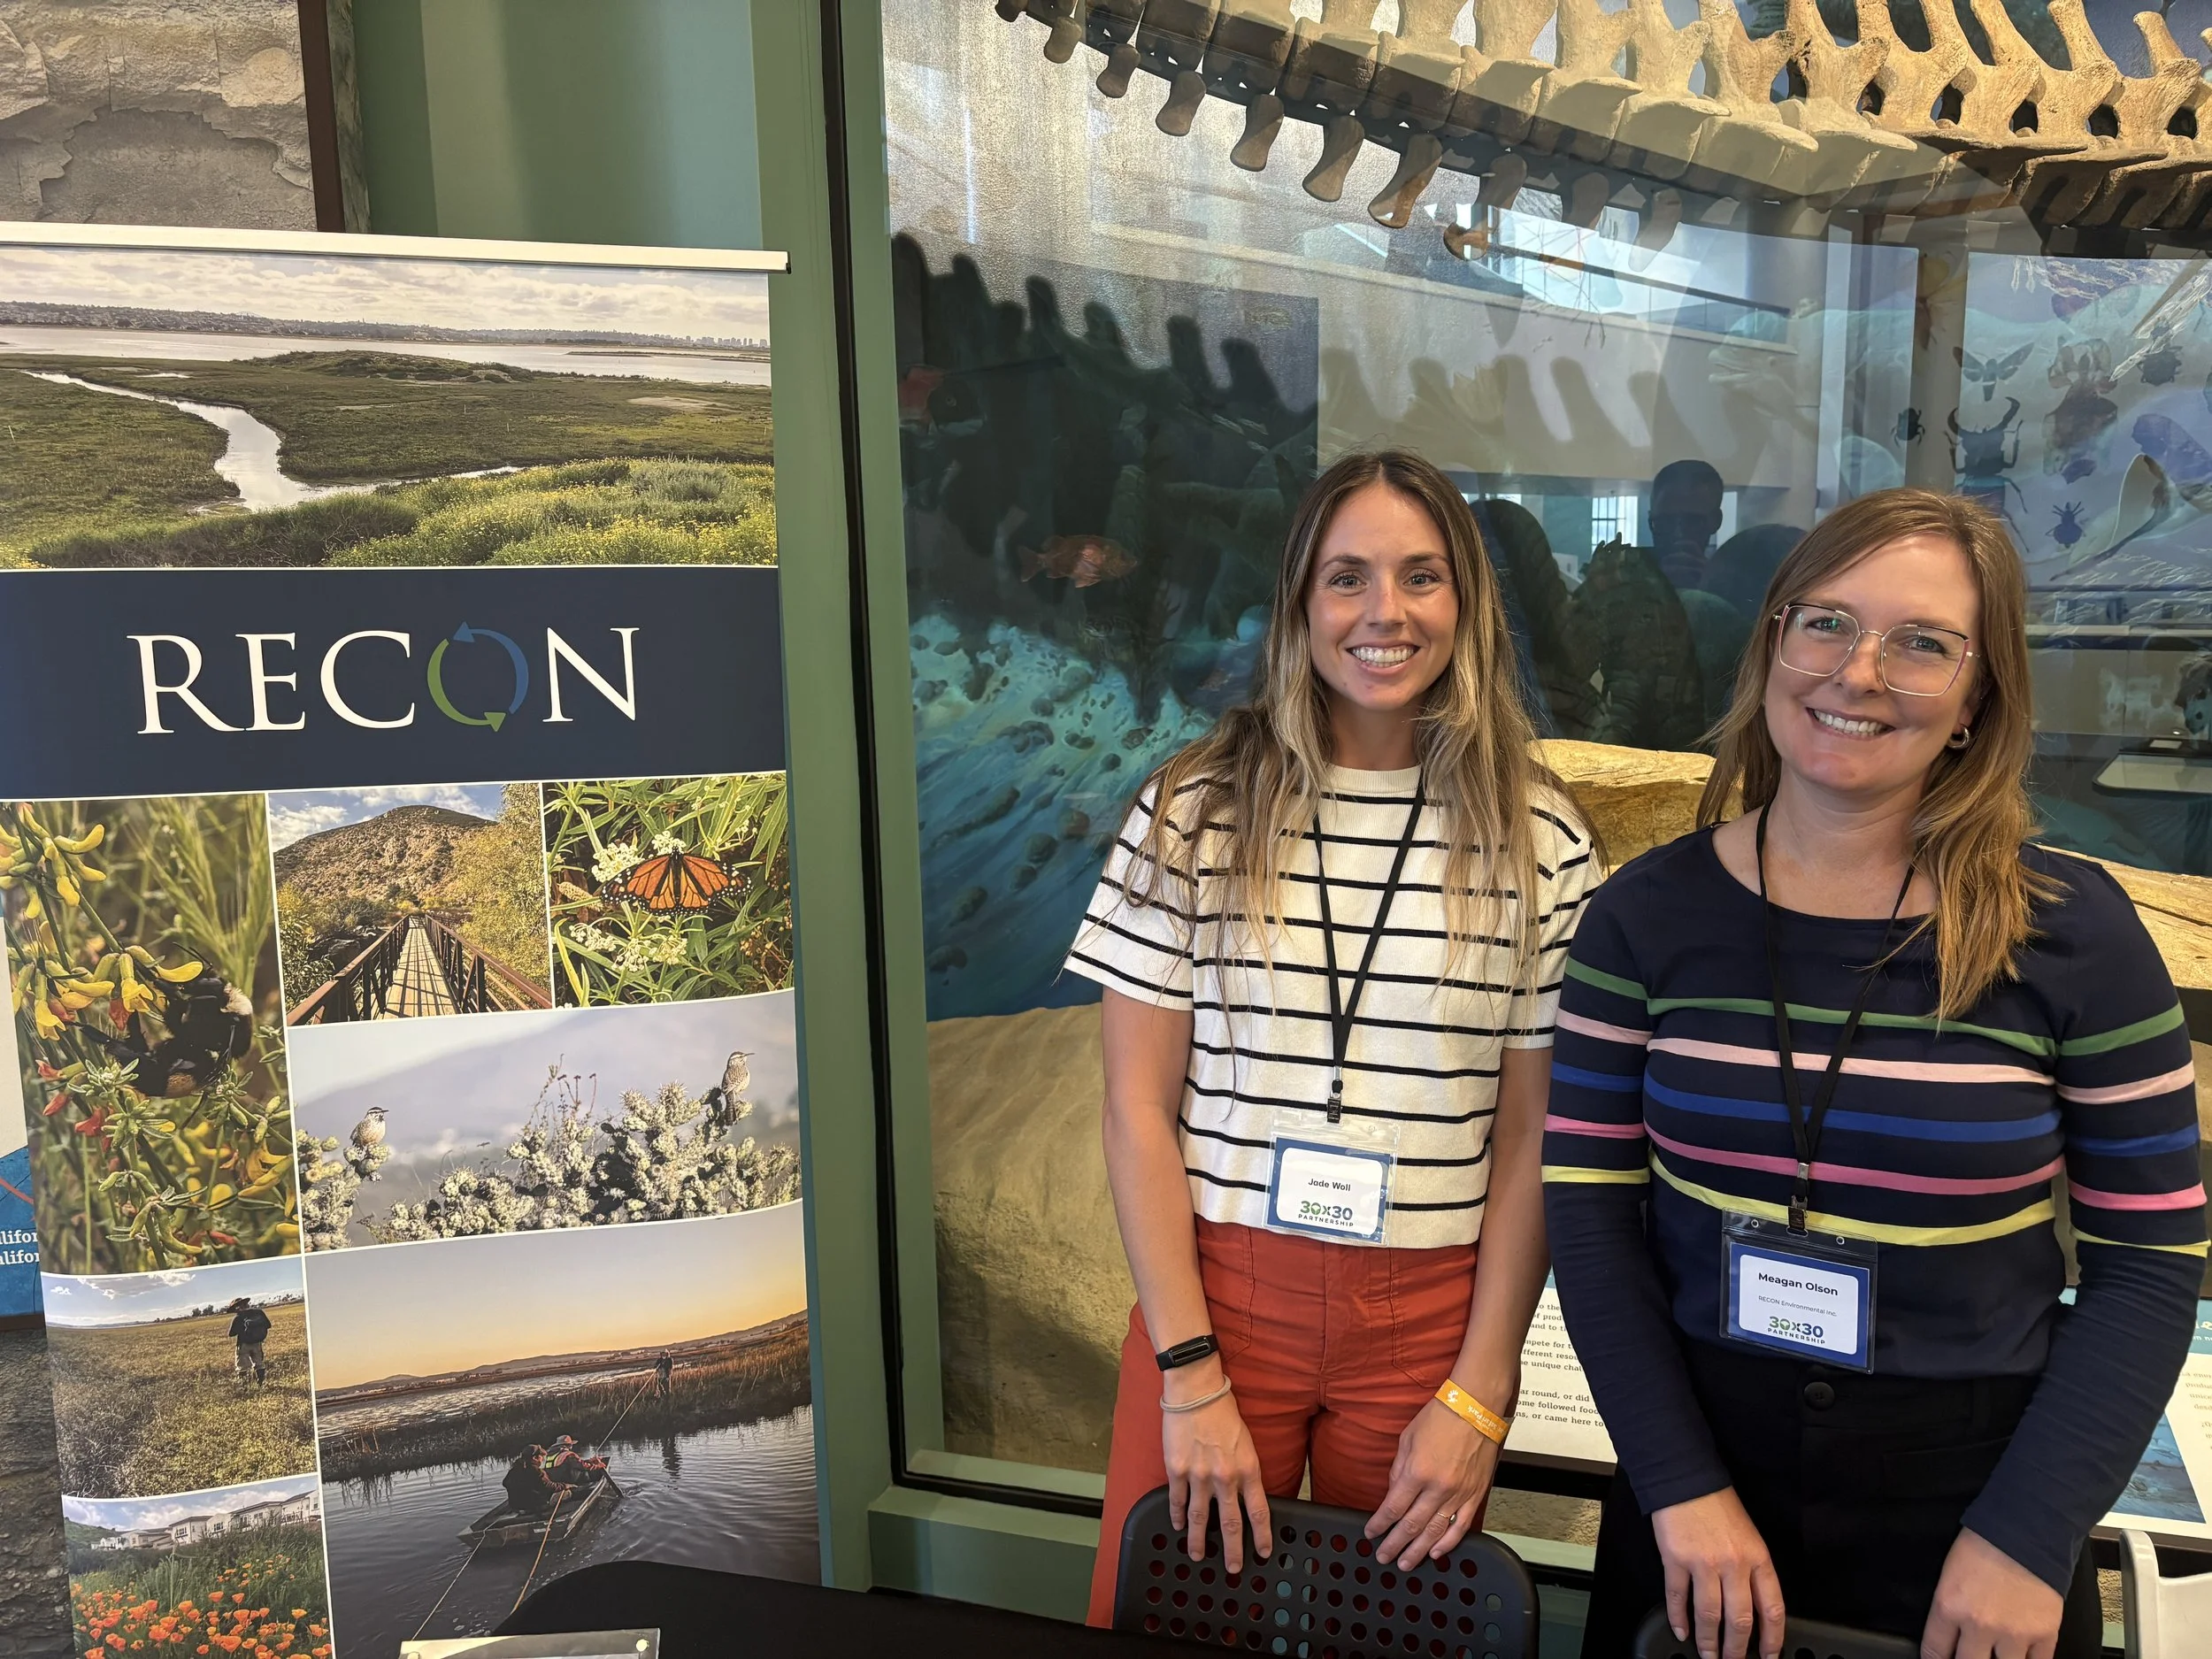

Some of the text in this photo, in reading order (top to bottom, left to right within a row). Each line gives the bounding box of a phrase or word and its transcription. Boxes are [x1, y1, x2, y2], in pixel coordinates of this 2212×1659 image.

[127, 622, 640, 734] RECON
[1308, 1179, 1351, 1192] Jade Woll
[1300, 1201, 1353, 1220] 30x30
[1298, 1213, 1354, 1226] PARTNERSHIP
[0, 1230, 38, 1245] lifor
[1758, 1272, 1839, 1295] Meagan Olson
[1758, 1295, 1780, 1304] RECON
[1781, 1300, 1825, 1314] Environmental
[1769, 1316, 1824, 1338] 30x30
[1767, 1327, 1825, 1344] PARTNERSHIP
[1531, 1361, 1562, 1370] unique
[1532, 1390, 1560, 1399] round,
[1538, 1401, 1577, 1412] followed
[1571, 1417, 1591, 1425] here
